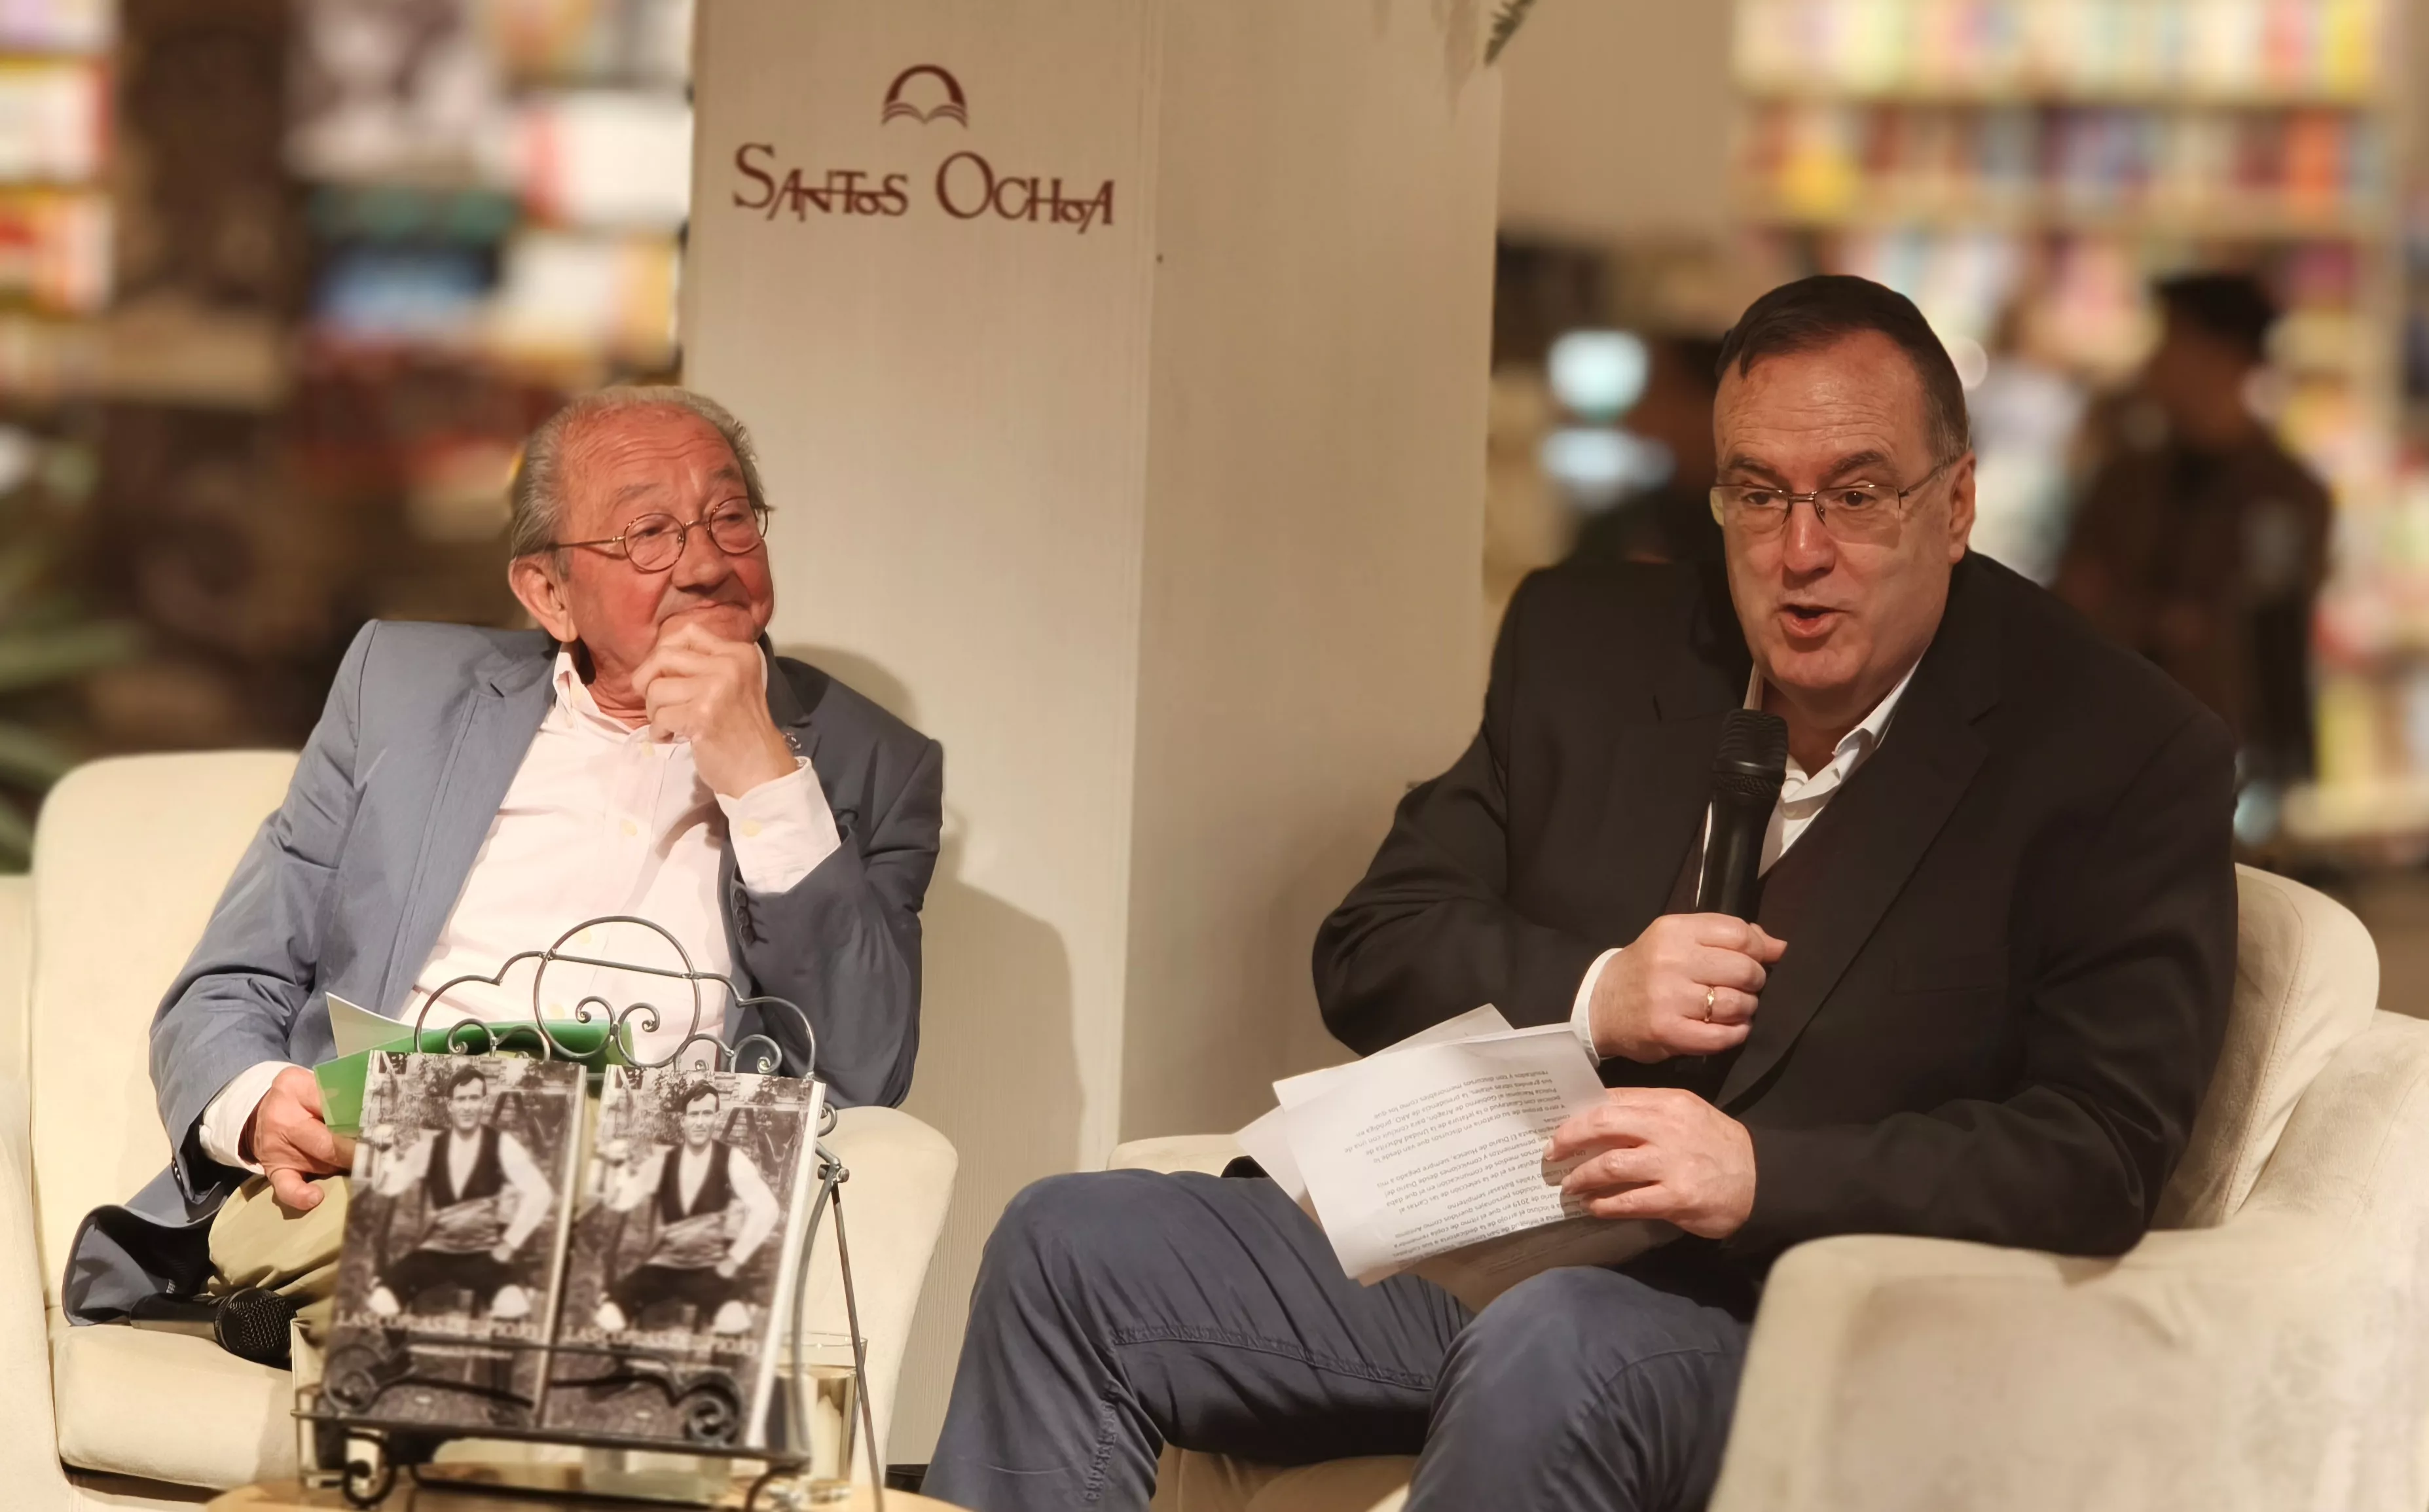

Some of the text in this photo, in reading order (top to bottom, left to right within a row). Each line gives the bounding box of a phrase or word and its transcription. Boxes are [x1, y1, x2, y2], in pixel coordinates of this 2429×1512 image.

[1410, 1117, 1426, 1127] para
[1404, 1128, 1429, 1142] Unidad
[1431, 1127, 1463, 1141] discursos
[1488, 1136, 1510, 1146] Diario
[1381, 1149, 1402, 1159] desde
[1494, 1154, 1519, 1166] medios
[1417, 1173, 1439, 1183] desde
[1406, 1198, 1429, 1210] Cartas
